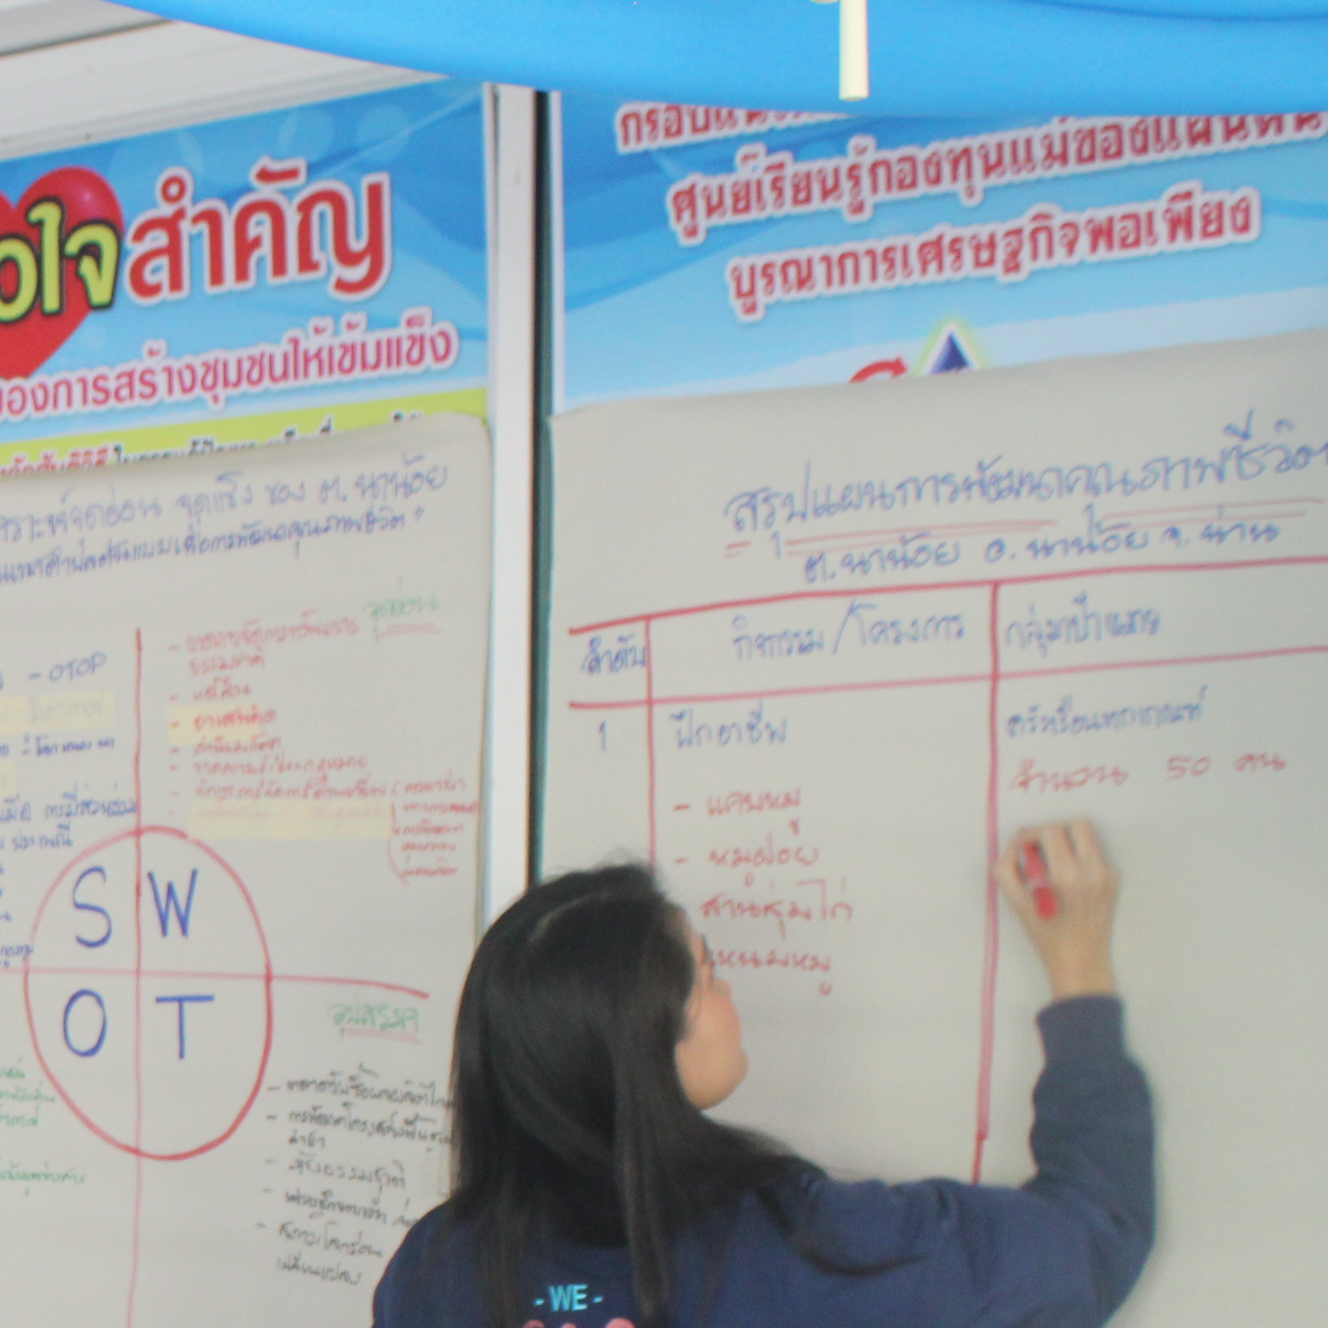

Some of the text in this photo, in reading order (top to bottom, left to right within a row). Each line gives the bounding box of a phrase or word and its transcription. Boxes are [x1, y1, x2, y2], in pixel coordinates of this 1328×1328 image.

[128, 164, 389, 299] สำคัญ
[731, 188, 1255, 315] บูรณาการเศรษฐกิจพอเพียง
[48, 651, 108, 682] OTOP
[1165, 755, 1213, 781] 50
[72, 865, 198, 949] S W
[62, 988, 215, 1060] O T
[548, 1283, 589, 1312] WE
